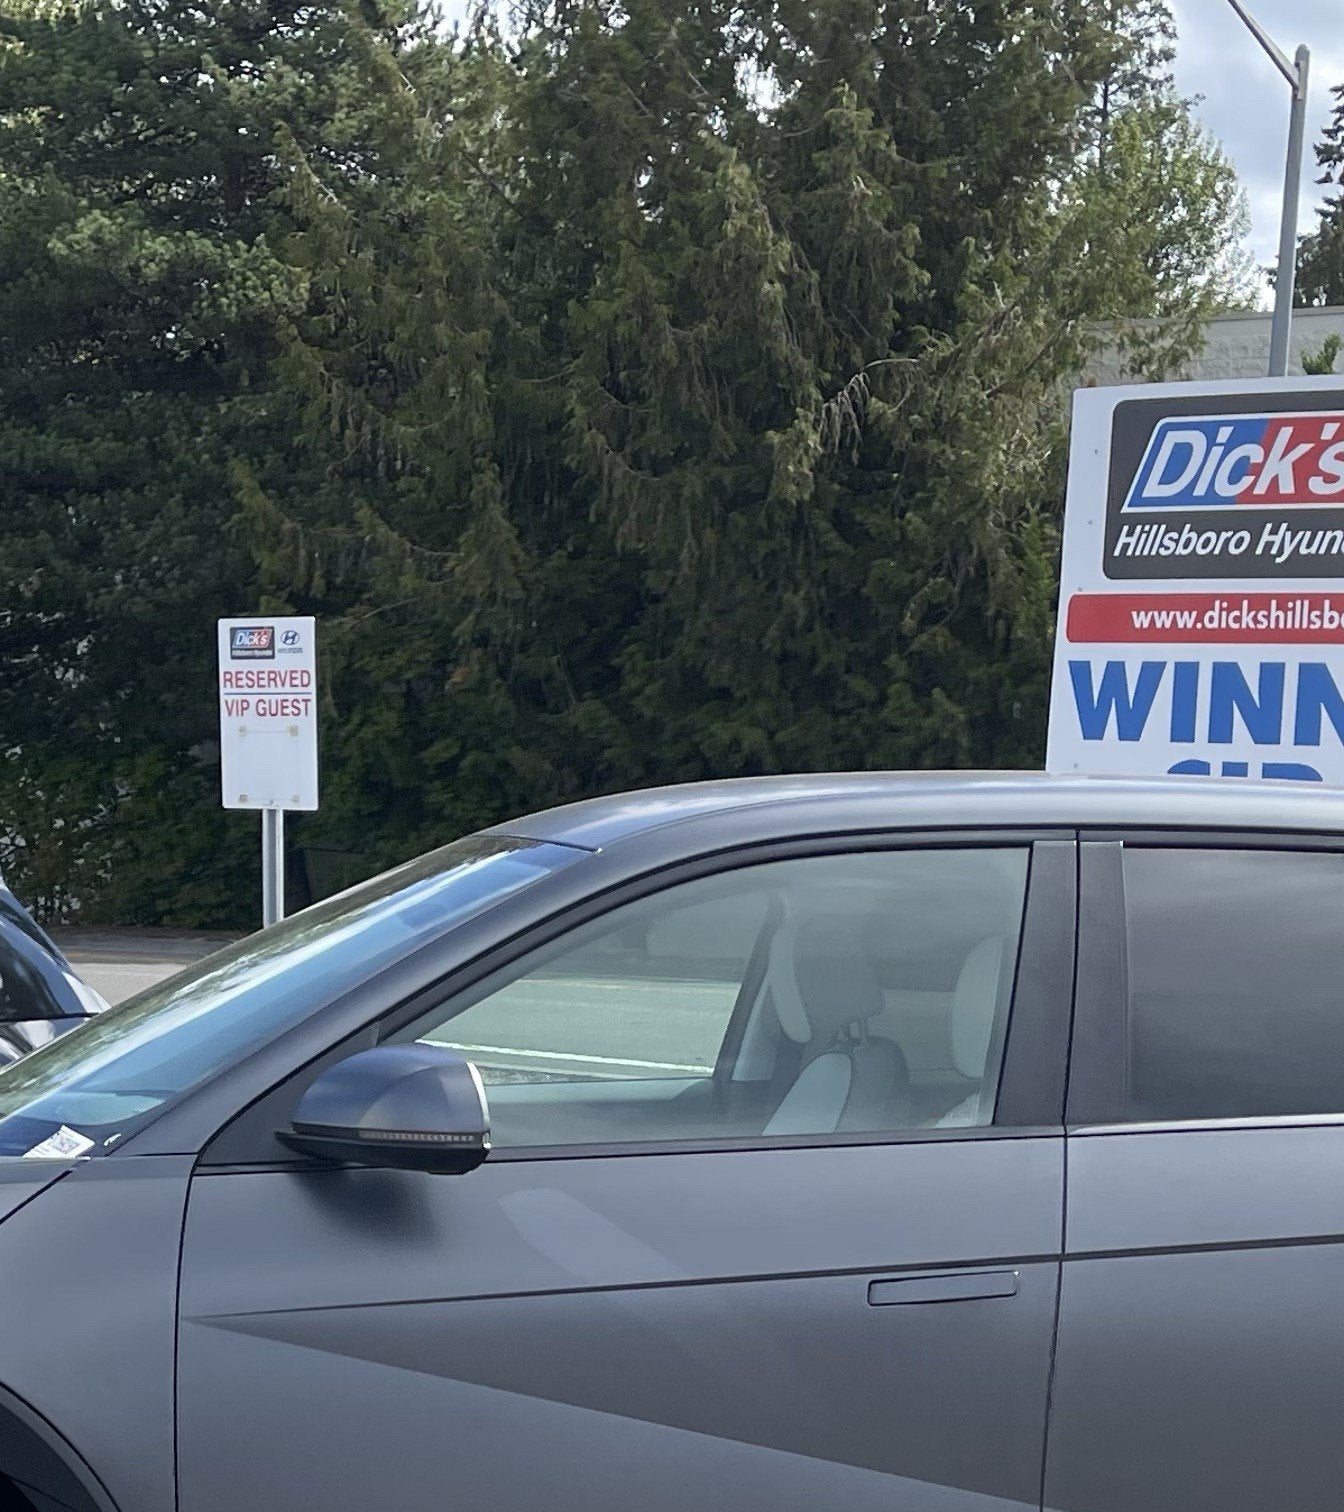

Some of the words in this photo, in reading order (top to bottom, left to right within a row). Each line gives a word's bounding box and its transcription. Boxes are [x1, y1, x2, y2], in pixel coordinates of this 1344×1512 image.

[1112, 523, 1252, 557] Hillsboro
[223, 670, 311, 688] RESERVED
[224, 699, 250, 717] VIP
[255, 698, 311, 717] GUEST
